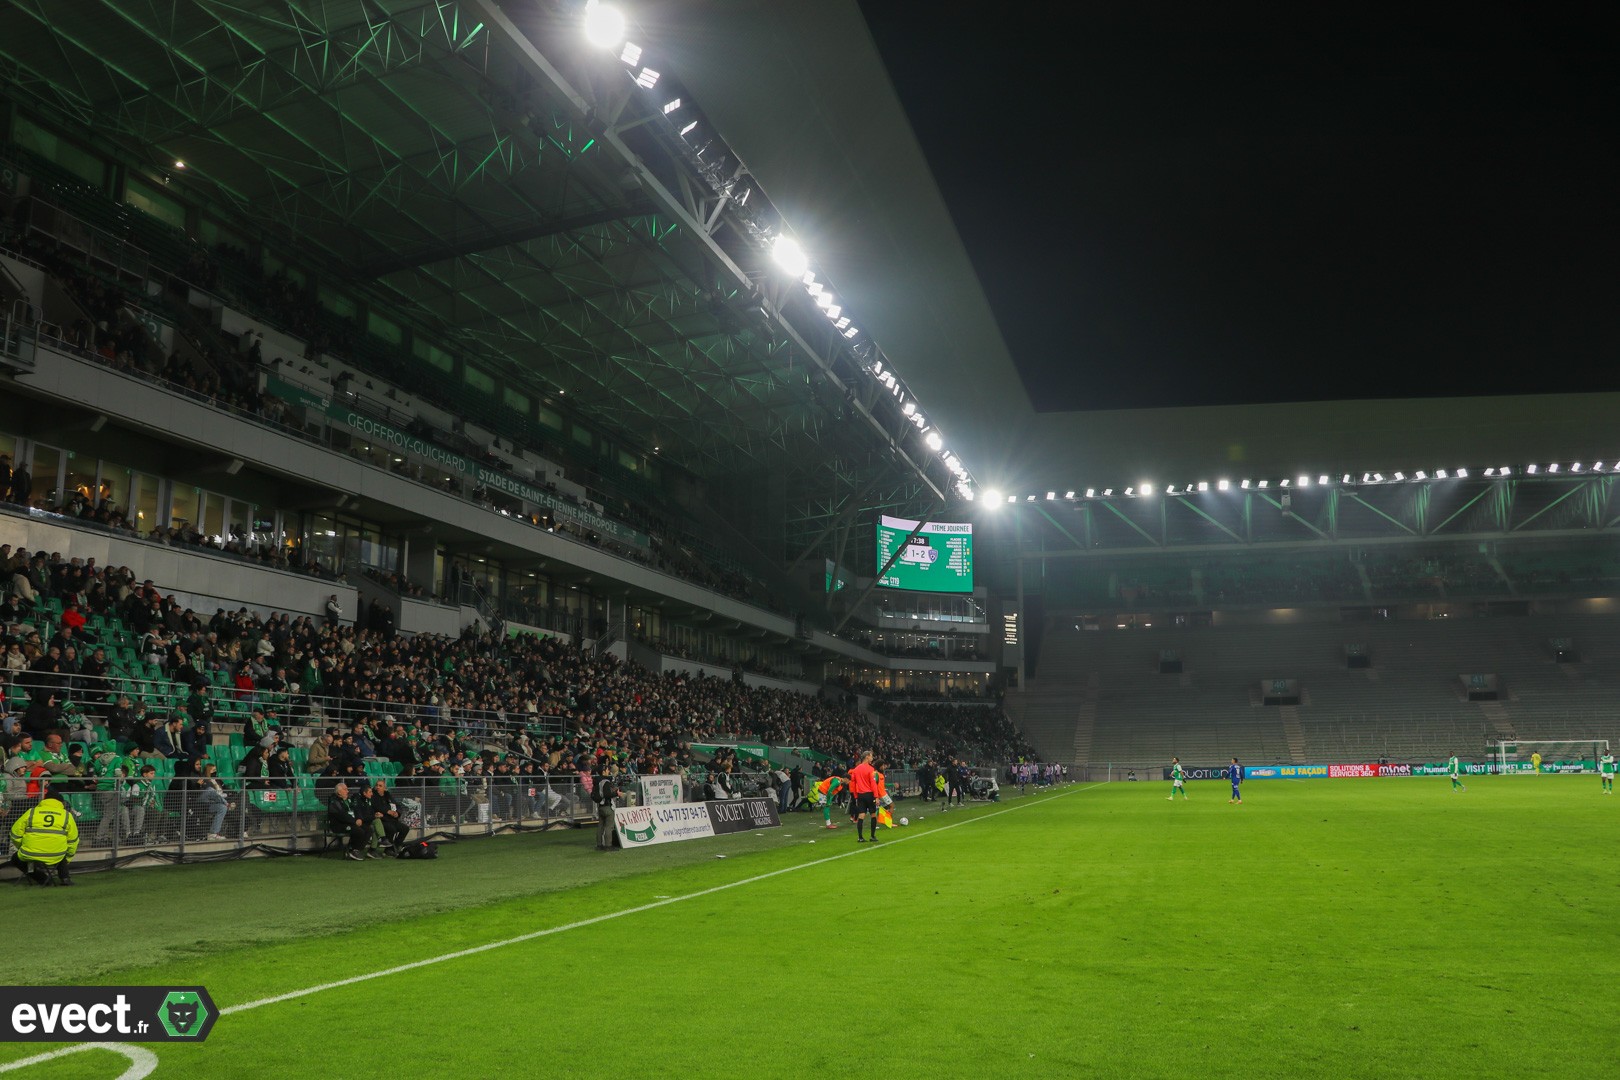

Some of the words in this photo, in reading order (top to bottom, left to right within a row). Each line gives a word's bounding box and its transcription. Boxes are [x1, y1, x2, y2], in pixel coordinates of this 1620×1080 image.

[347, 412, 466, 472] GEOFFROY-GUICHARD
[479, 469, 507, 490] STADE
[508, 481, 520, 495] DE
[520, 486, 577, 518] SAINT-ÉTIENNE
[1281, 767, 1296, 776] BAS
[1297, 766, 1327, 777] FAÇADE
[1423, 765, 1450, 773] humm
[1464, 764, 1487, 773] VISIT
[663, 809, 674, 822] 04
[673, 808, 682, 821] 77
[681, 807, 690, 820] 37
[690, 807, 699, 819] 94
[698, 806, 707, 818] 75
[746, 801, 770, 818] LOIRE
[43, 815, 55, 827] 9
